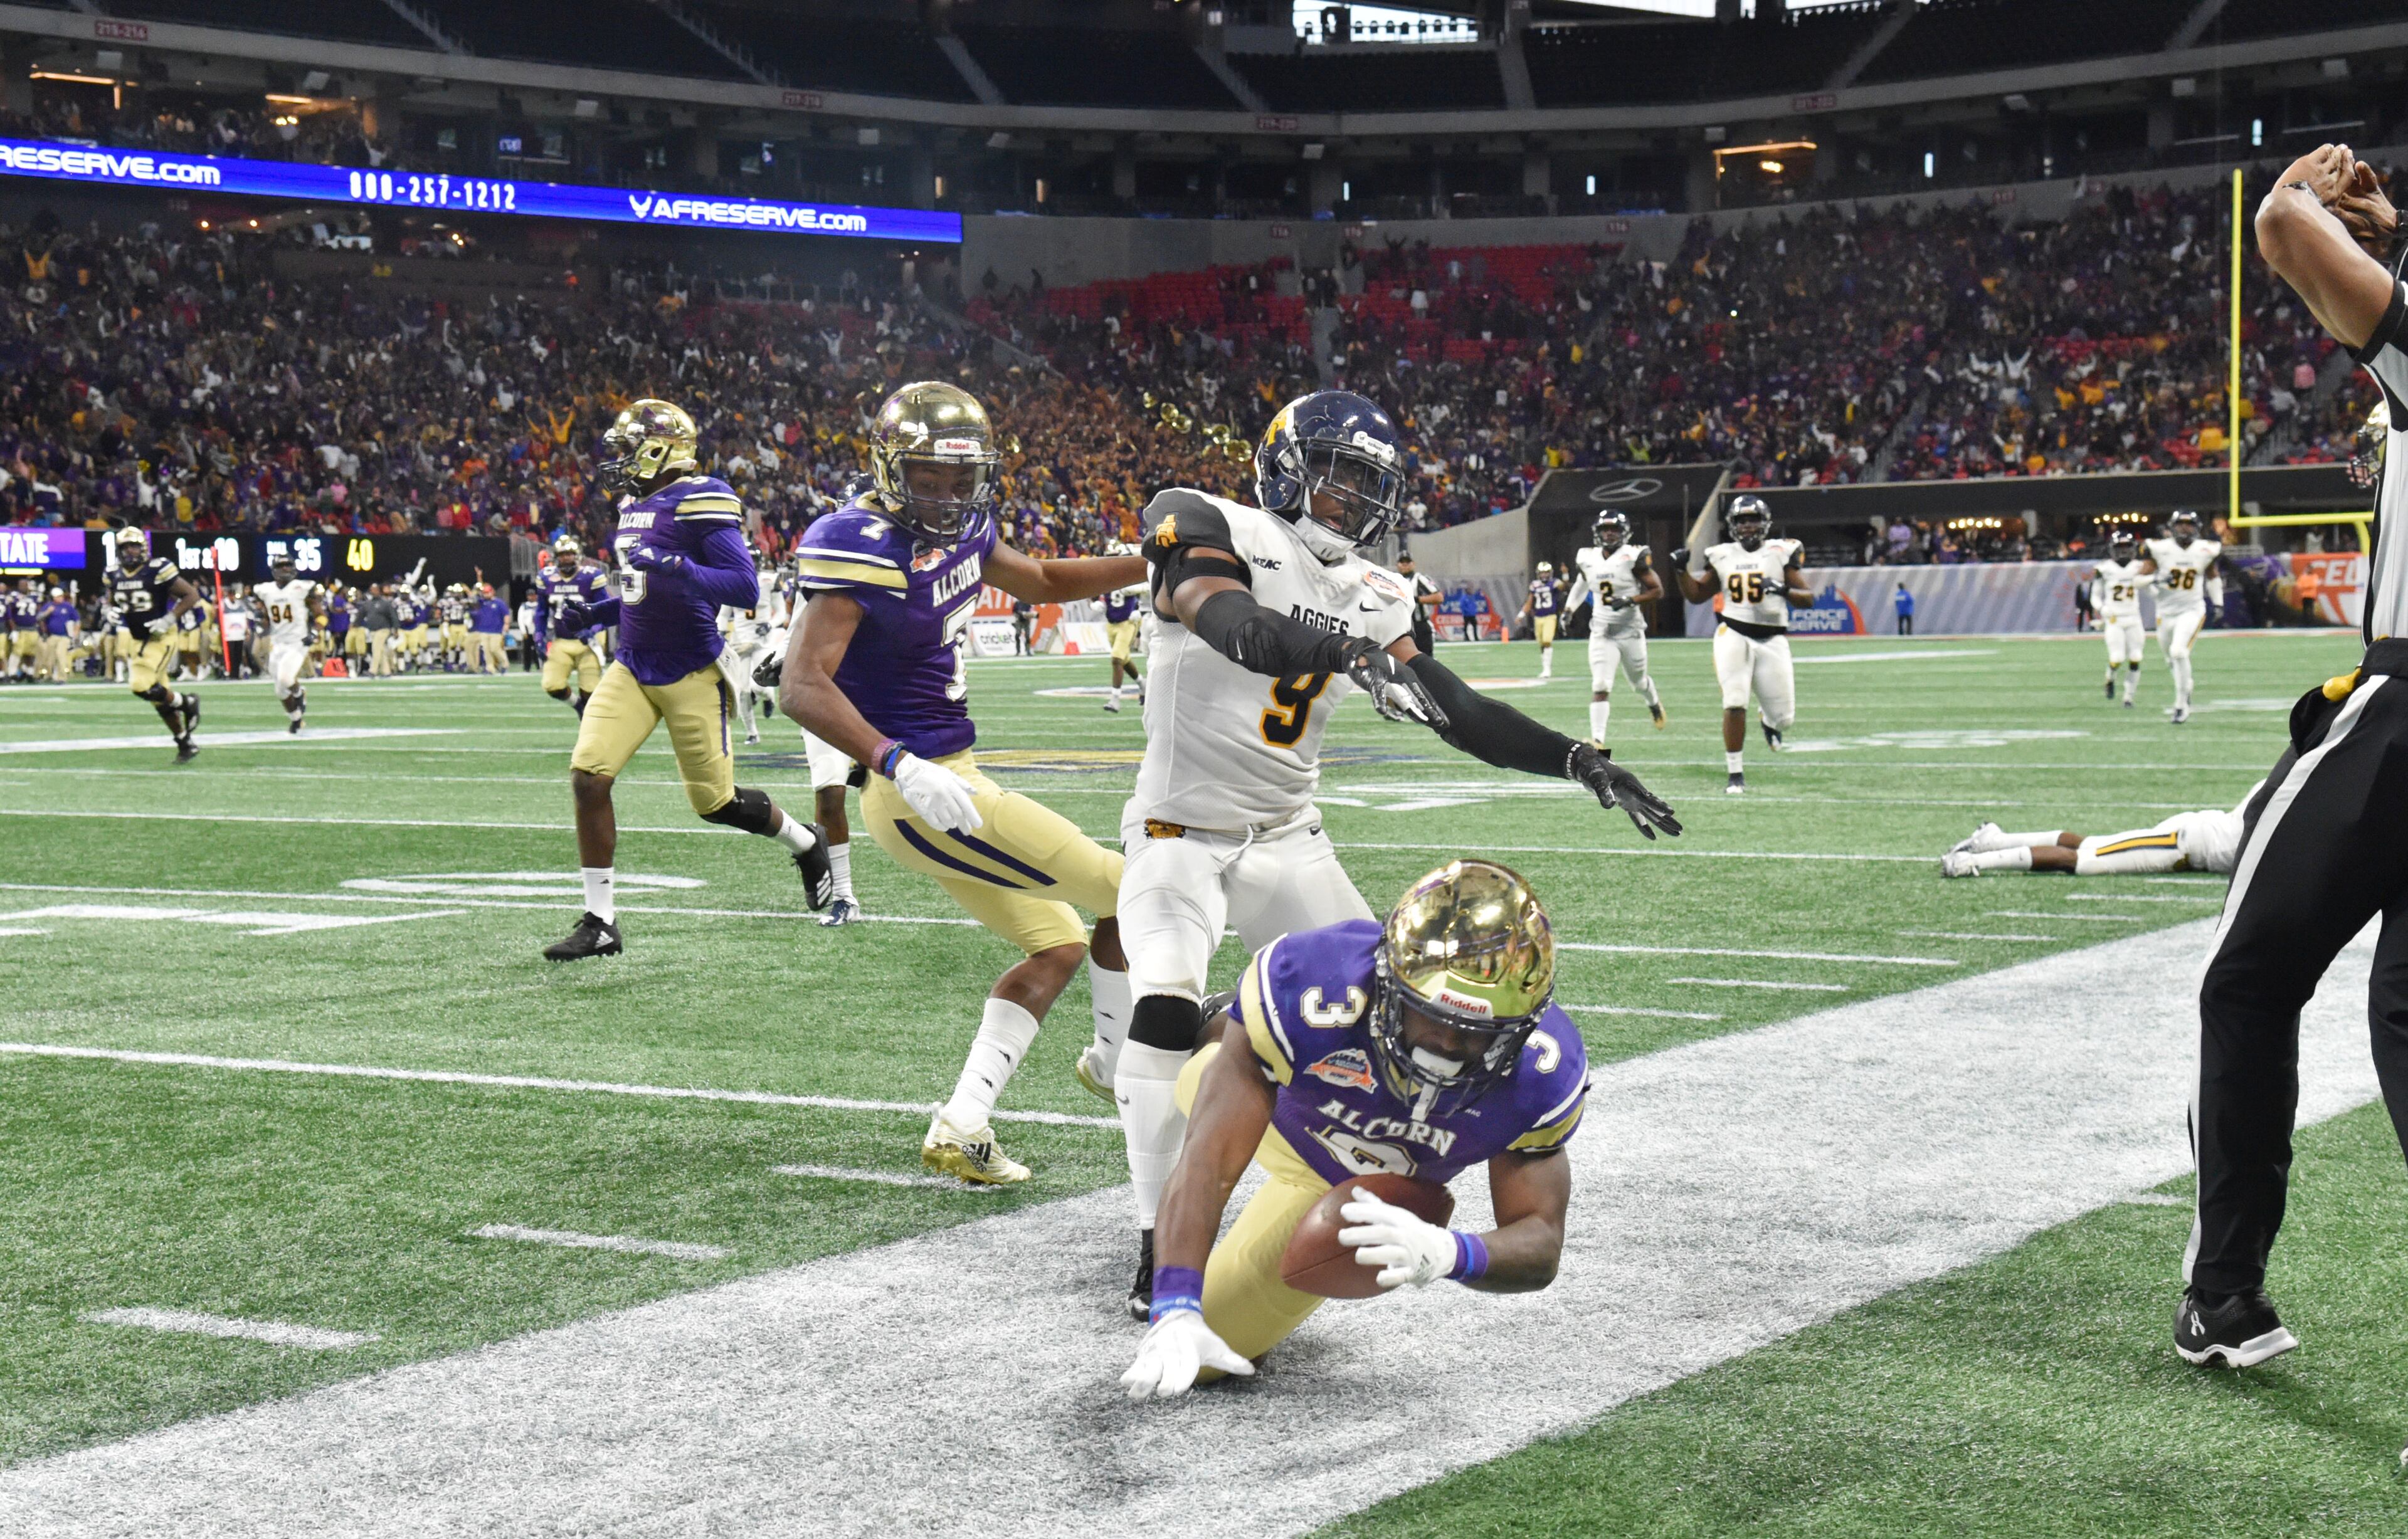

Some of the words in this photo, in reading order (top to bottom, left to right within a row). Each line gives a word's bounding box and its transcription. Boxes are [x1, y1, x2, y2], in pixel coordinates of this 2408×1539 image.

[0, 145, 220, 185] RESERVE.com
[653, 199, 867, 231] AFRESERVE.com
[946, 441, 969, 450] Riddell
[618, 512, 657, 530] ALCORN
[860, 515, 895, 540] 7
[294, 538, 321, 571] 35
[347, 539, 373, 571] 40
[614, 533, 647, 605] 5
[1252, 555, 1282, 570] MEAC
[932, 552, 981, 607] ALCORN
[1600, 580, 1615, 606] 2
[1728, 572, 1764, 604] 95
[271, 604, 293, 623] 94
[1534, 592, 1553, 609] 13
[1291, 604, 1349, 636] AGGIES
[980, 632, 1015, 644] cricket
[1259, 671, 1334, 748] 9
[1300, 985, 1368, 1028] 3
[1440, 994, 1487, 1014] Riddell
[1316, 1098, 1457, 1157] ALCORN
[962, 1145, 987, 1174] adidas
